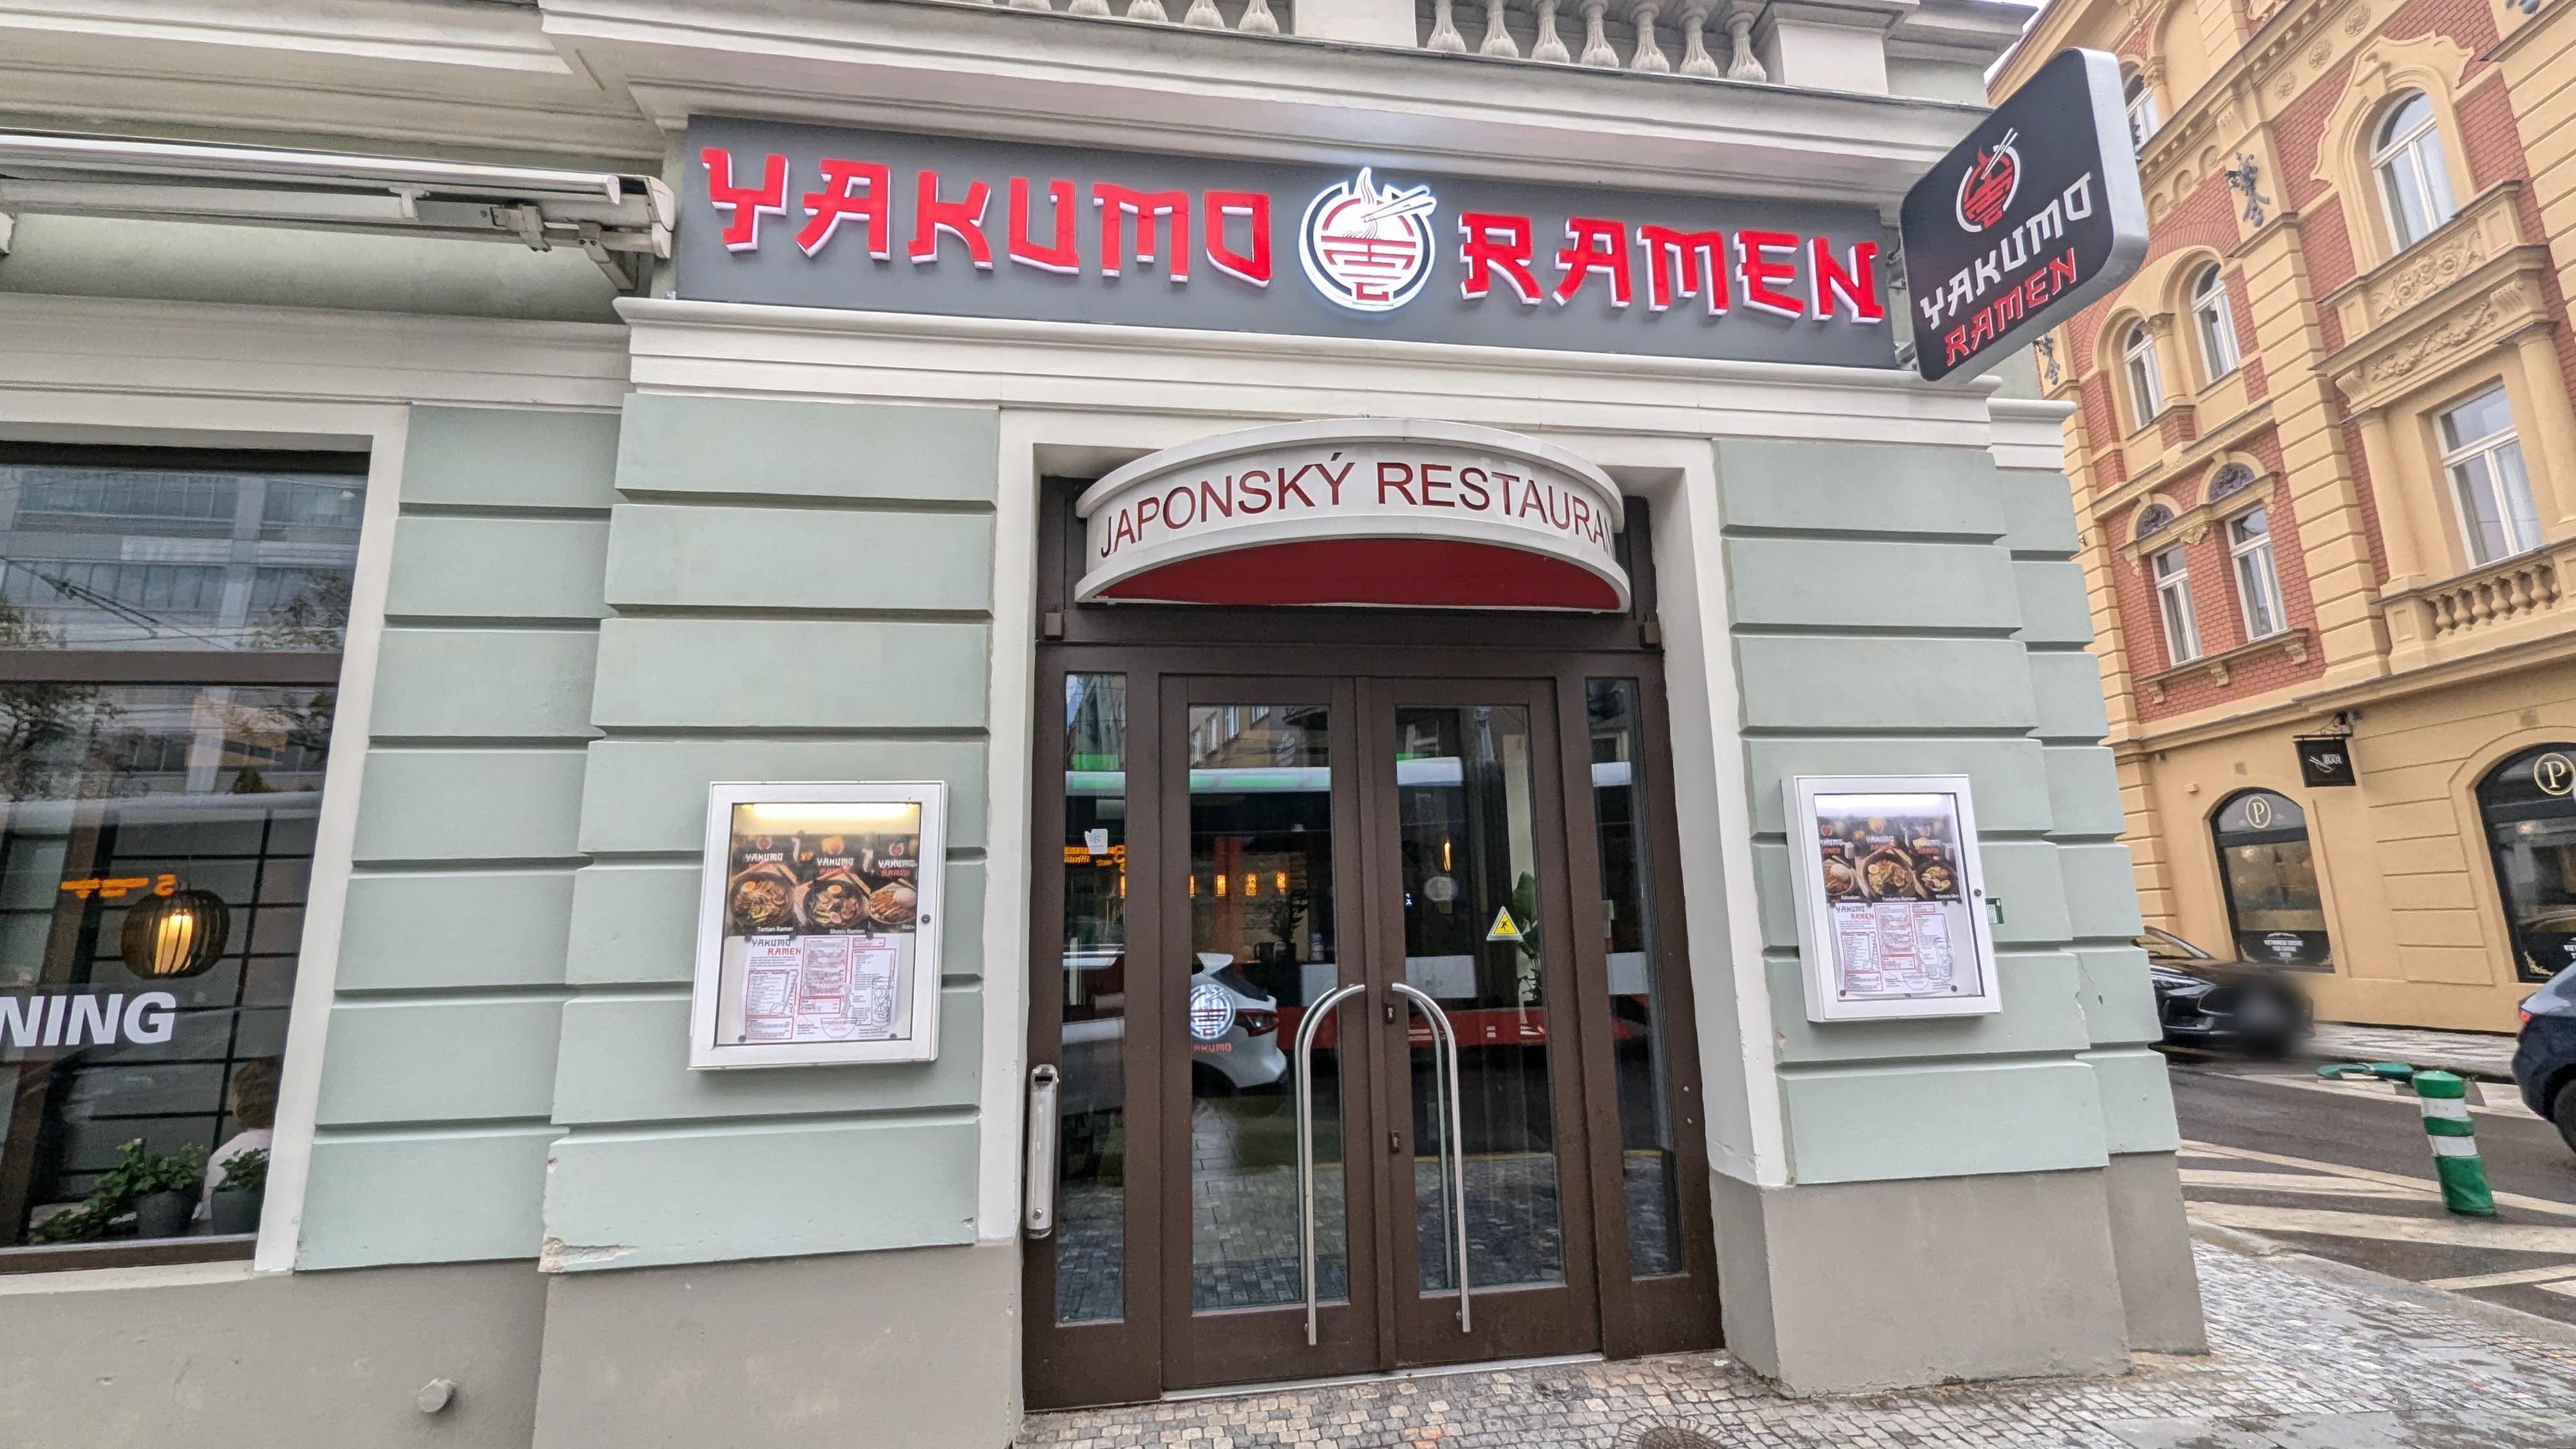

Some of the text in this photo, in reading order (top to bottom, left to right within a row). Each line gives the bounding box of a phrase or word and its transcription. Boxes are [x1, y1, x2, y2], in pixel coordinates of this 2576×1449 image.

[701, 147, 1884, 325] YAKUMO RAMEN
[1920, 171, 2092, 330] YAKUMO
[1944, 247, 2076, 367] RAMEN
[1101, 452, 1354, 558] JAPONSKÝ
[745, 853, 784, 862] YAKUMO
[817, 857, 855, 867] YAKUMO
[752, 939, 791, 947] YAKUMO
[0, 992, 176, 1046] NING
[1194, 1043, 1232, 1052] AKUMO
